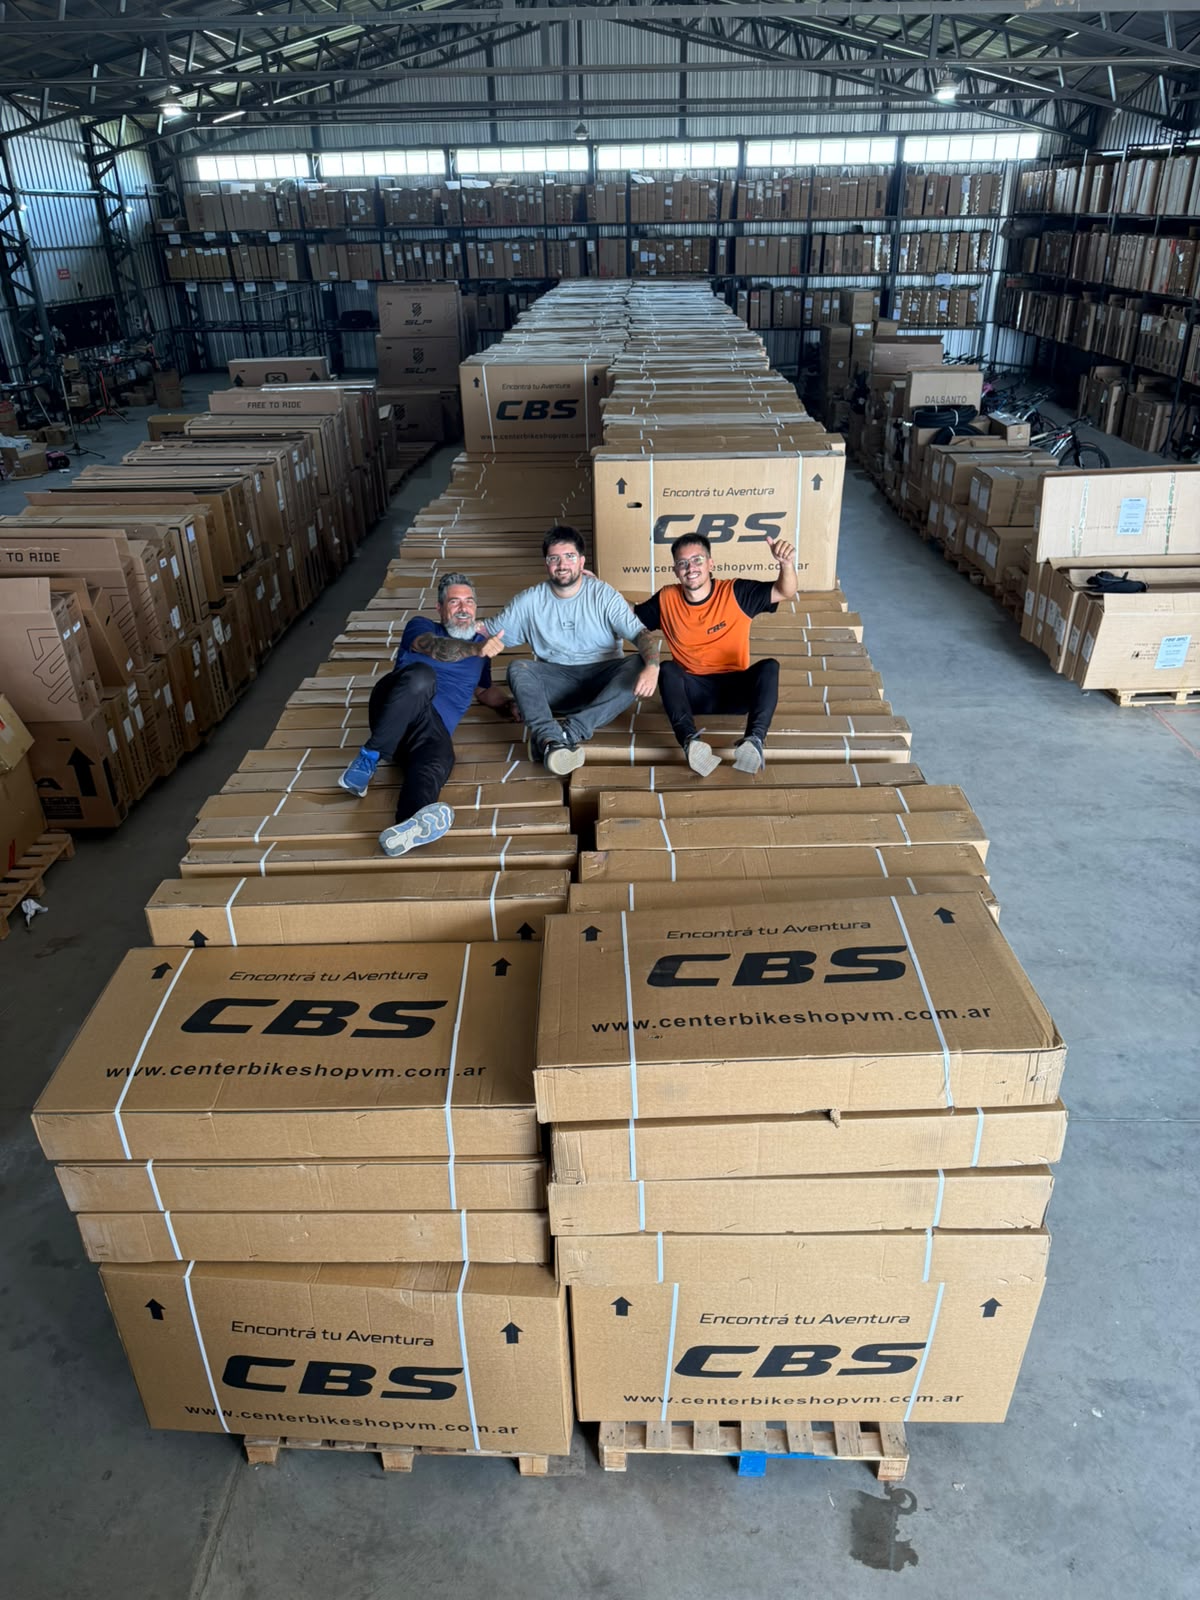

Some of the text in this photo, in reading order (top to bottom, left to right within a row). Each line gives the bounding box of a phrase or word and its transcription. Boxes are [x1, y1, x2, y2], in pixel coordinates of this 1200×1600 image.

[502, 383, 532, 391] Encontrá
[247, 401, 301, 409] FREE TO RIDE
[925, 395, 967, 404] DALSANTO
[496, 399, 579, 421] CBS
[662, 487, 775, 498] Encontrá tu Aventura
[650, 511, 787, 545] CBS
[6, 552, 24, 562] TO
[29, 552, 61, 562] RIDE
[707, 620, 727, 635] CBS
[666, 921, 872, 940] Encontrá tu Aventura
[228, 970, 429, 982] Encontrá tu Aventura
[646, 945, 907, 988] CBS
[180, 997, 449, 1039] CBS
[591, 1006, 991, 1033] www.centerbikeshopvm.com.ar
[700, 1312, 911, 1325] Encontrá tu Aventura
[231, 1320, 435, 1347] Encontrá tu Aventura
[674, 1342, 927, 1379] CBS
[221, 1354, 464, 1401] CBS
